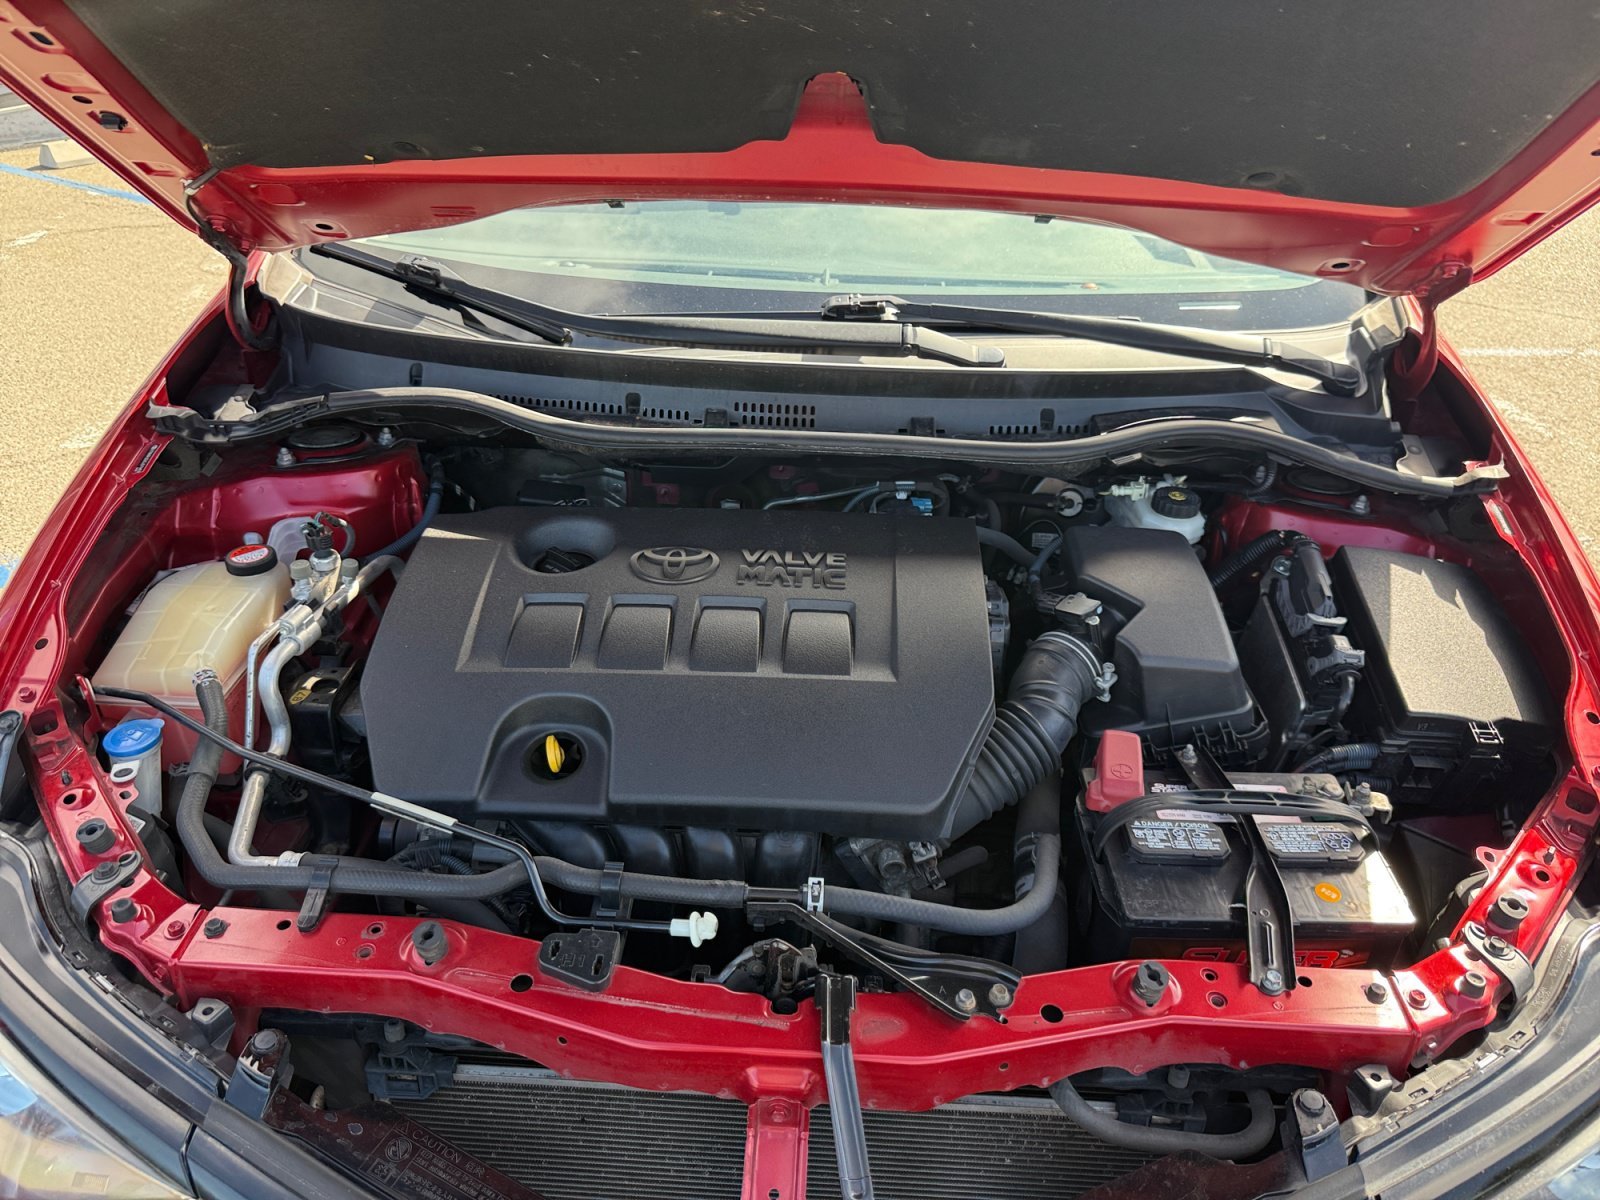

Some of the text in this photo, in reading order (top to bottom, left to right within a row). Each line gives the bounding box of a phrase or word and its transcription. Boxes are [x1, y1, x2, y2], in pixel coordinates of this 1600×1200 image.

[741, 549, 848, 567] VALVE
[736, 564, 847, 589] MATIC
[1141, 820, 1173, 828] DANGER
[1182, 947, 1341, 969] SUER
[412, 1128, 463, 1164] CAUTION
